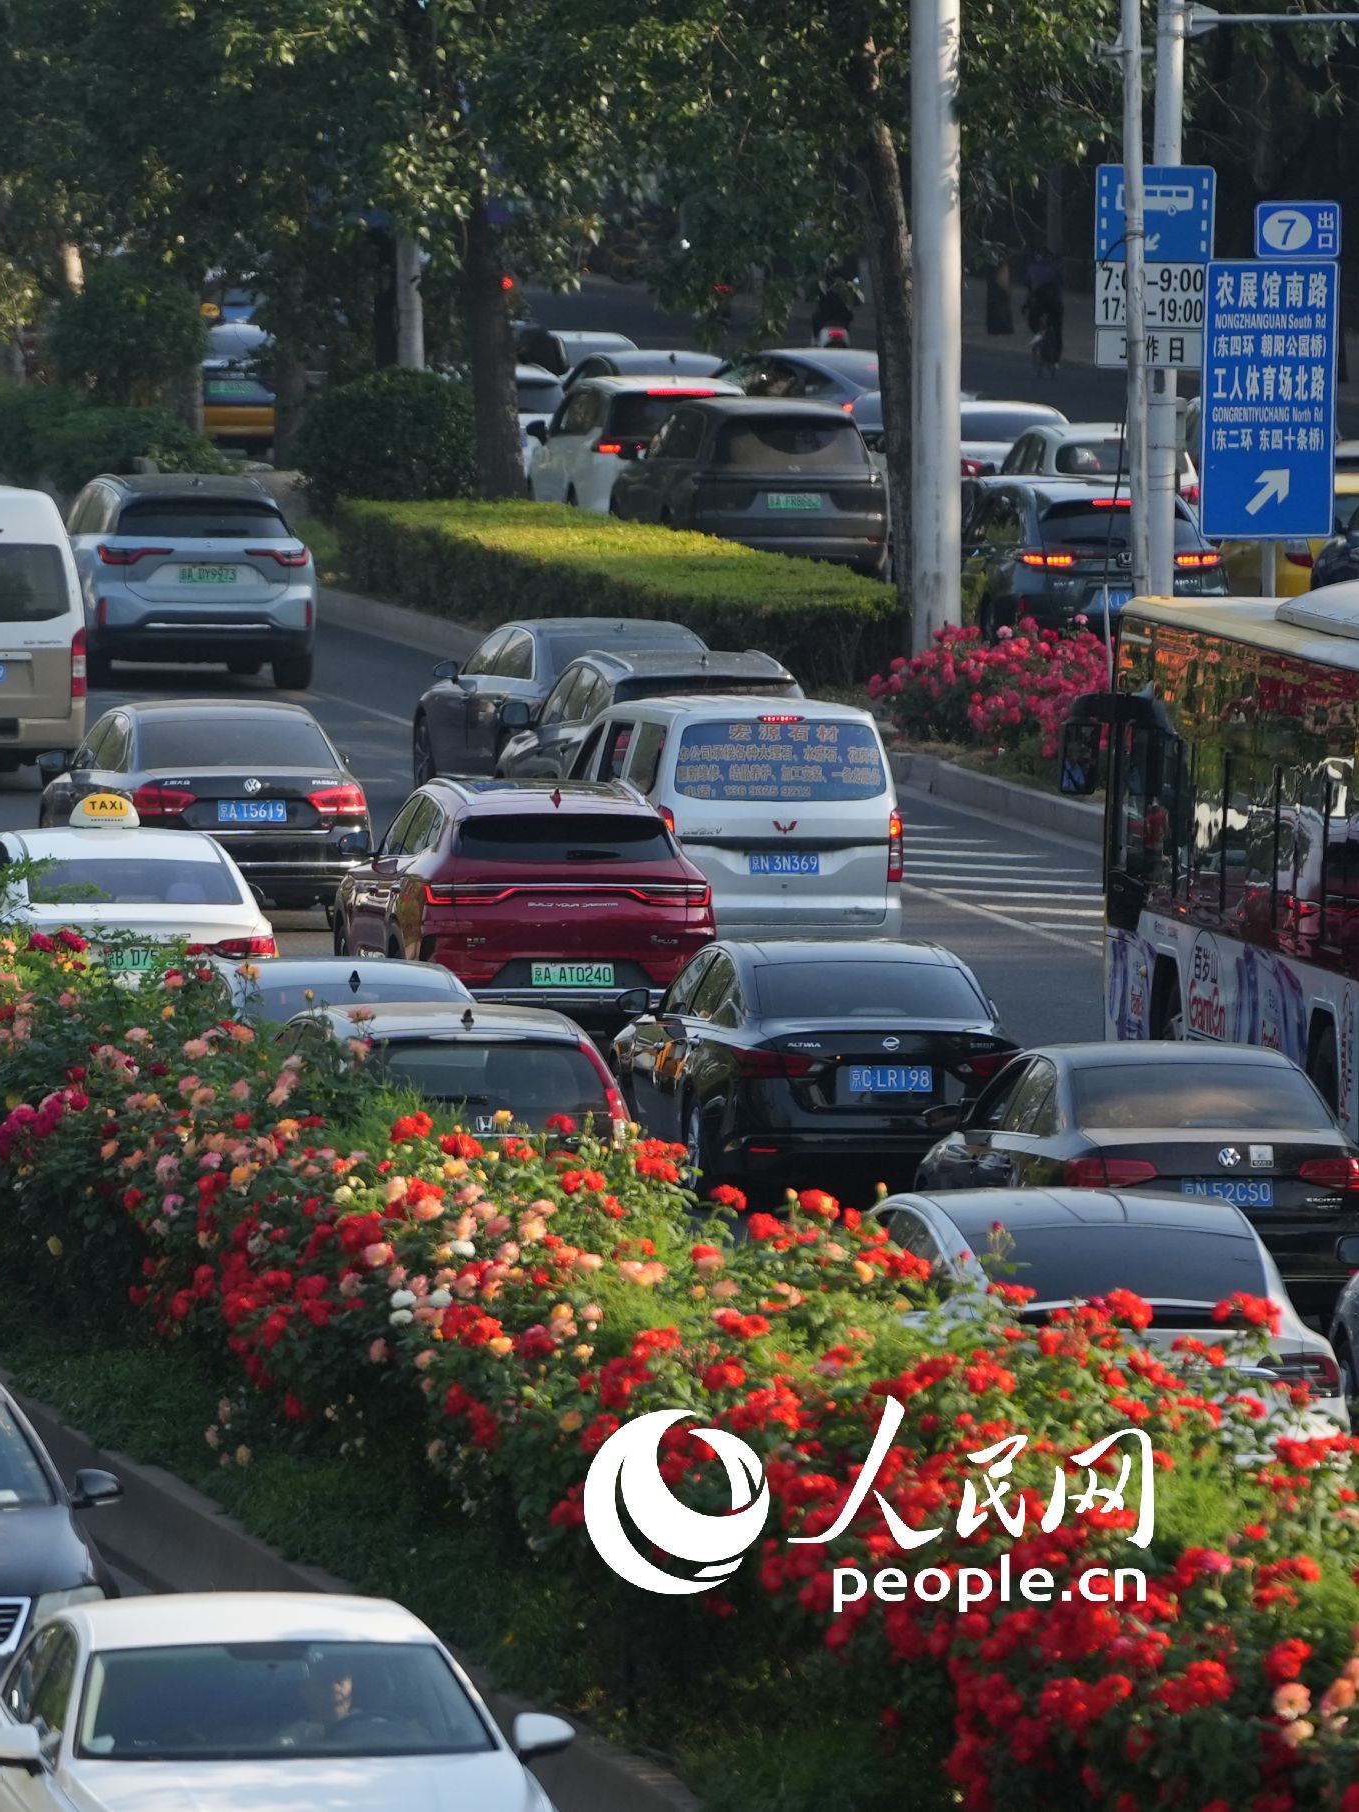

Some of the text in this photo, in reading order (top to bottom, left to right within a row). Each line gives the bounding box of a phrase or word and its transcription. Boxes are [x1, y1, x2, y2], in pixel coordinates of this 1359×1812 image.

[1277, 218, 1297, 245] 7
[1317, 211, 1334, 249] 出口
[1215, 271, 1328, 309] 农展馆南路
[1215, 313, 1326, 329] NONGZHANGUAN South Rd
[1213, 365, 1325, 401] 工人体育场北路
[1212, 406, 1323, 422] GONGRENTIYUCHANG North Rd
[729, 724, 839, 742] 宏源石材
[89, 801, 123, 810] TAXI
[1194, 946, 1219, 984] 百岁山
